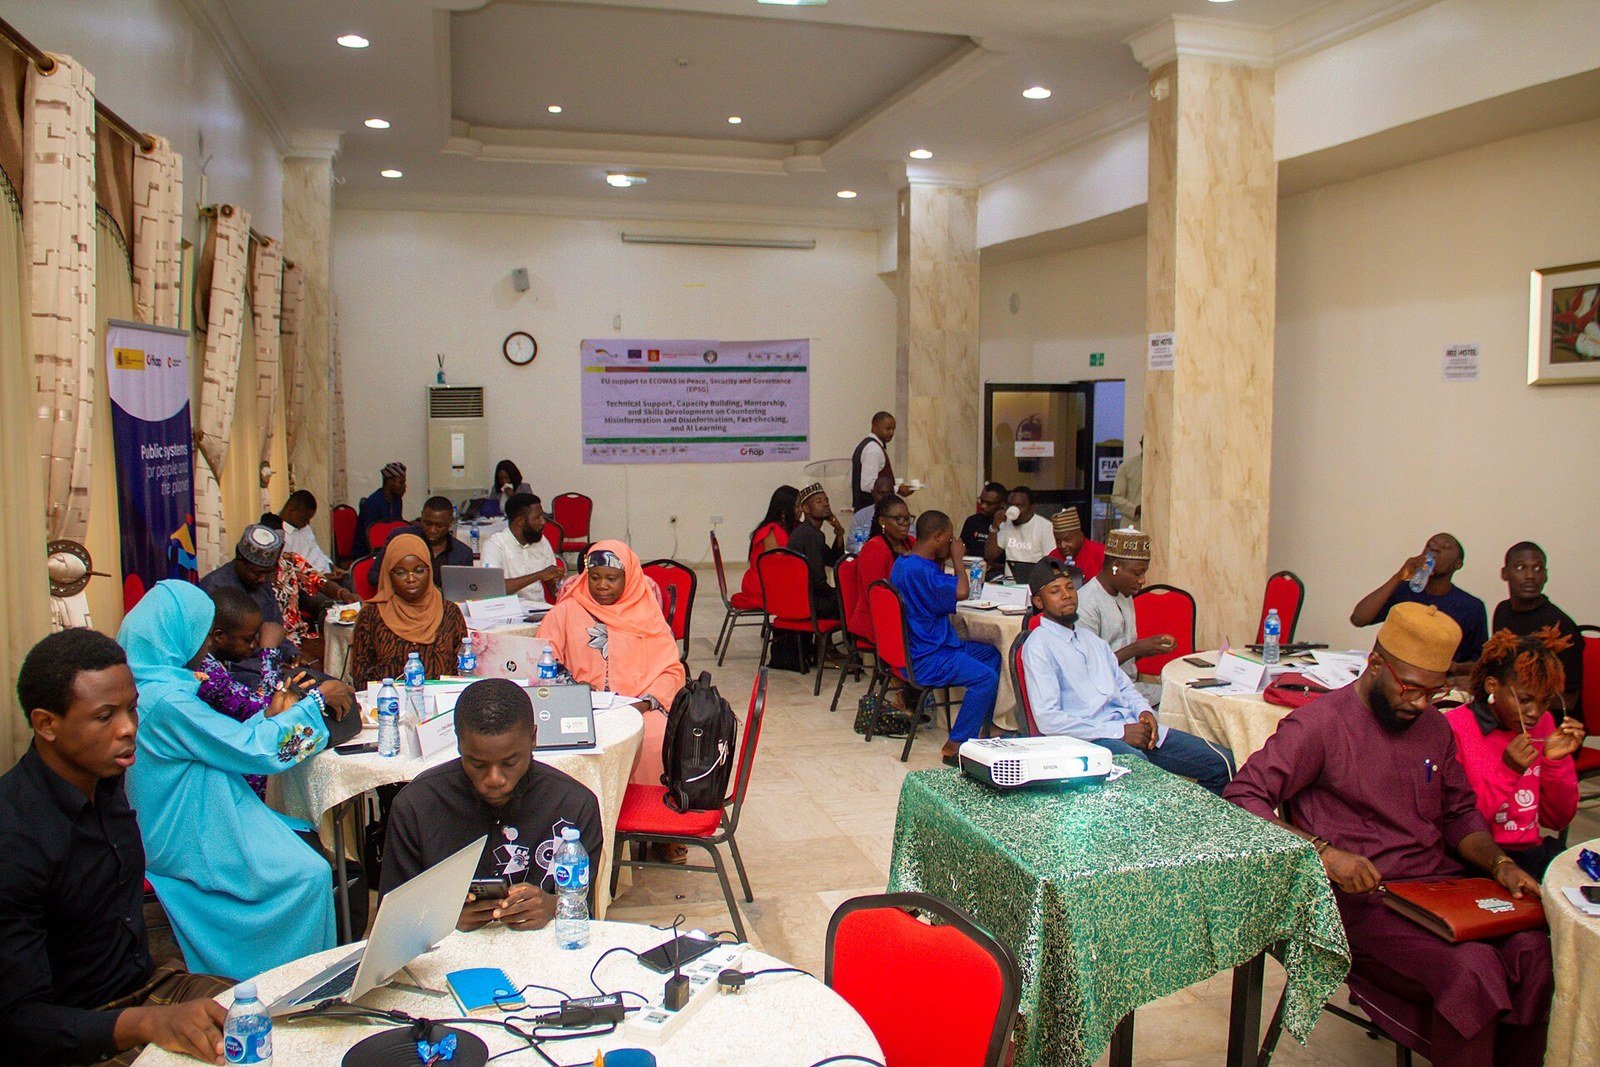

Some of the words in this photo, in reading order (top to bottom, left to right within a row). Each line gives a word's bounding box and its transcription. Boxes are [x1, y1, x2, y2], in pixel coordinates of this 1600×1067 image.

[612, 378, 639, 386] support
[686, 378, 709, 386] Peace,
[709, 377, 737, 386] Security
[642, 400, 675, 409] Support,
[676, 400, 709, 409] Capacity
[709, 400, 743, 408] Building,
[744, 399, 787, 408] Mentorship,
[665, 408, 714, 416] Development
[726, 408, 767, 416] Countering
[678, 416, 736, 424] Disinformation,
[736, 416, 789, 424] Fact-checking,
[141, 443, 163, 460] Public
[163, 443, 188, 461] systems
[1008, 538, 1032, 550] Boss
